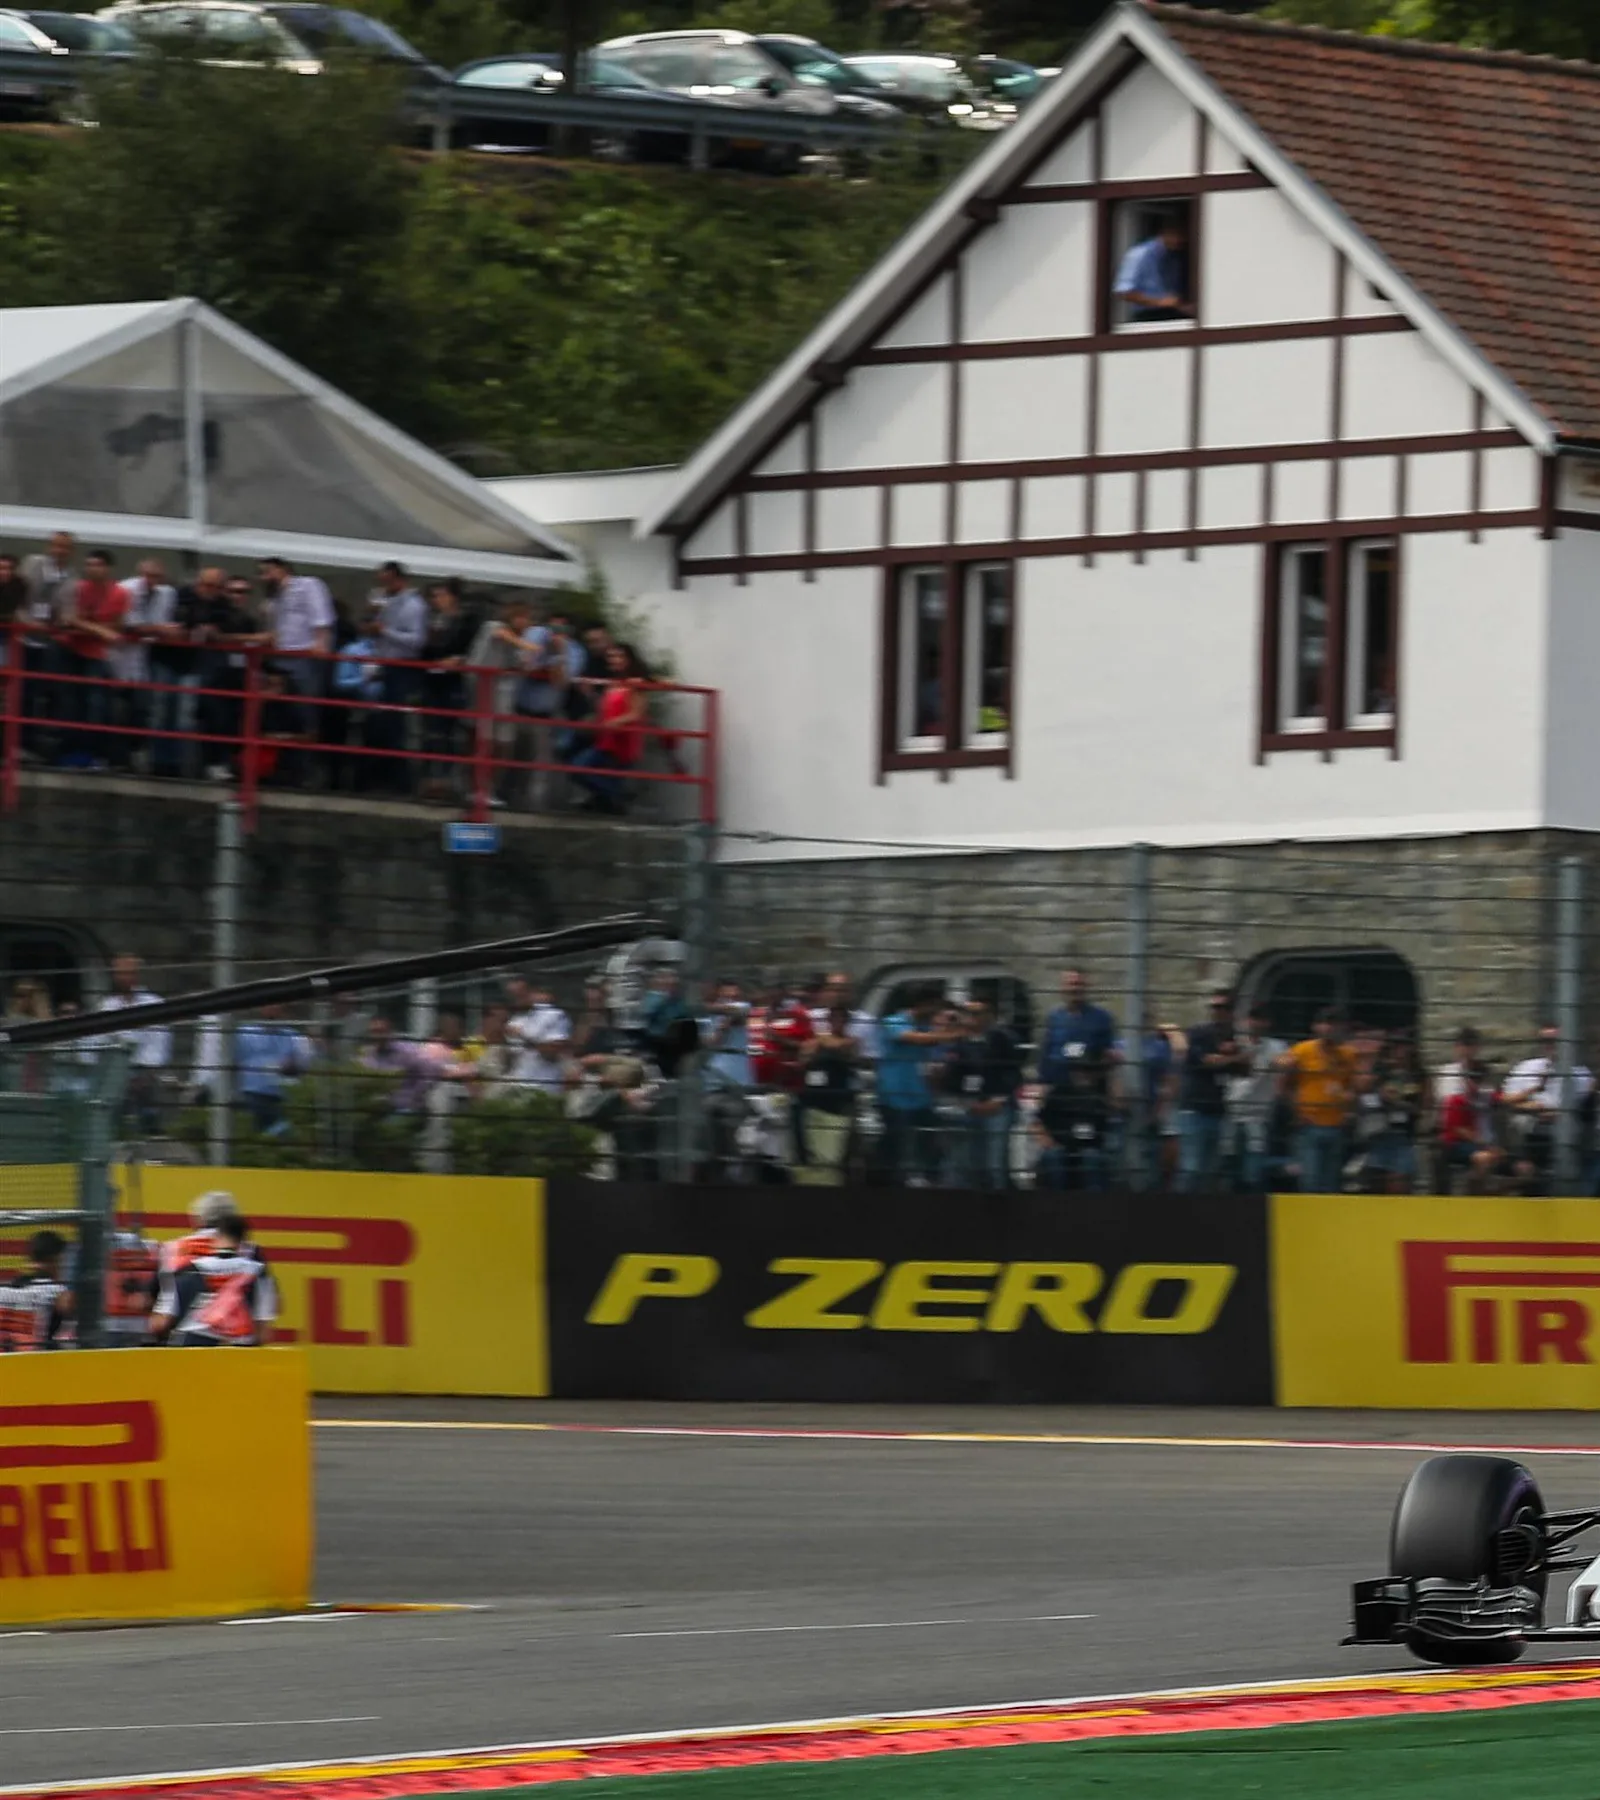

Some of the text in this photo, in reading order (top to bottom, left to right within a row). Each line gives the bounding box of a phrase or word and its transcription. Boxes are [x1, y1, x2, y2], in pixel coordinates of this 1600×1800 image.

[588, 1253, 1239, 1334] P ZERO
[0, 1400, 170, 1580] RELLI
